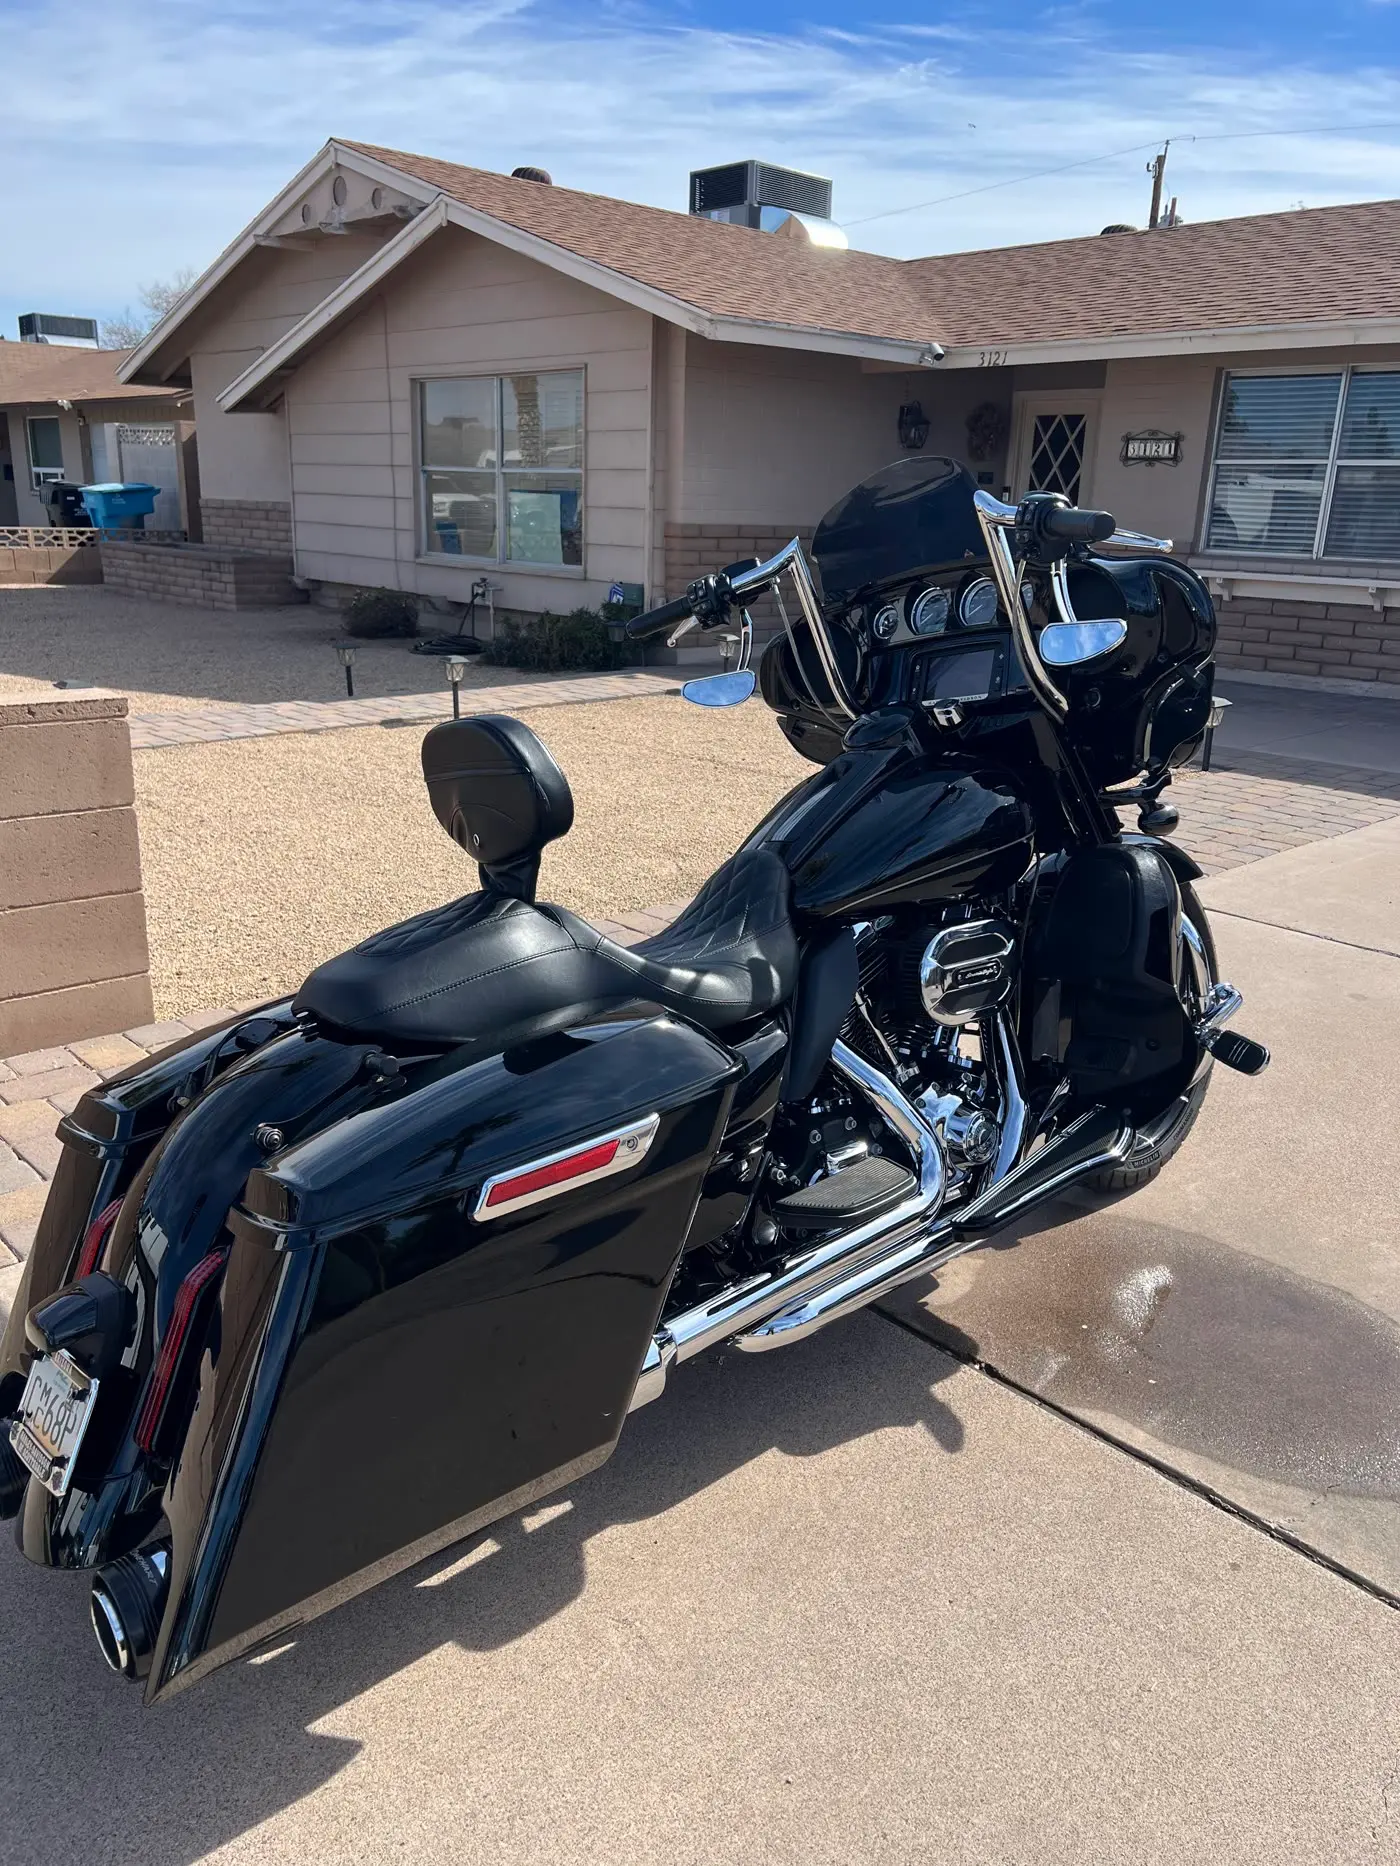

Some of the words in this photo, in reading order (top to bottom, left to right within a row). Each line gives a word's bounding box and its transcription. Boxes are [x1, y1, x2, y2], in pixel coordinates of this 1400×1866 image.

[979, 351, 1008, 367] 3121
[1128, 441, 1173, 458] 3121
[1133, 1152, 1160, 1168] MICHELIN
